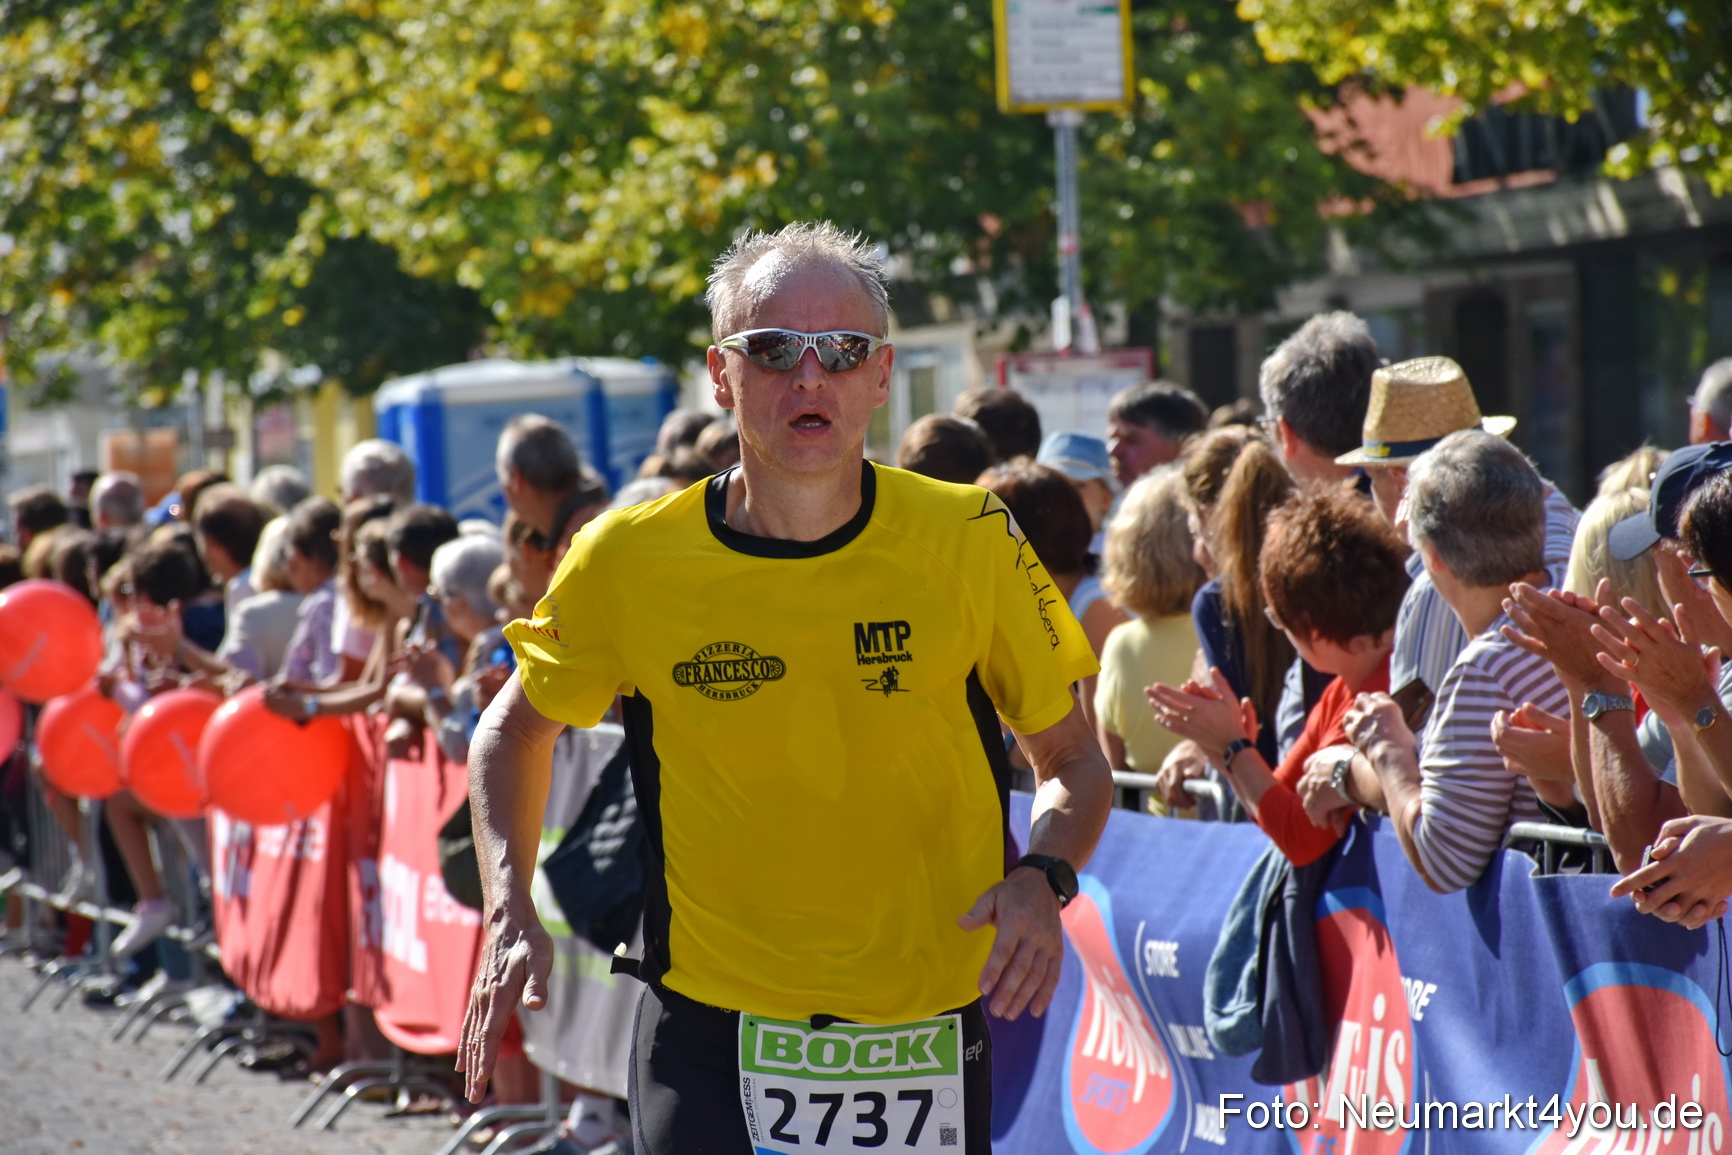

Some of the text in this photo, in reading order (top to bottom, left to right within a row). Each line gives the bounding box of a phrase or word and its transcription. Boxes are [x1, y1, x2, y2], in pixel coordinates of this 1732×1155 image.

[853, 620, 911, 655] MTP
[694, 643, 756, 664] PIZZERIA
[856, 651, 914, 666] Hersbruck
[684, 659, 771, 684] FRANCESCO
[698, 681, 760, 699] HERSBRUCK
[1400, 976, 1438, 1021] ORE
[754, 1023, 943, 1075] BOCK
[963, 1039, 984, 1062] ep
[764, 1088, 934, 1148] 2737
